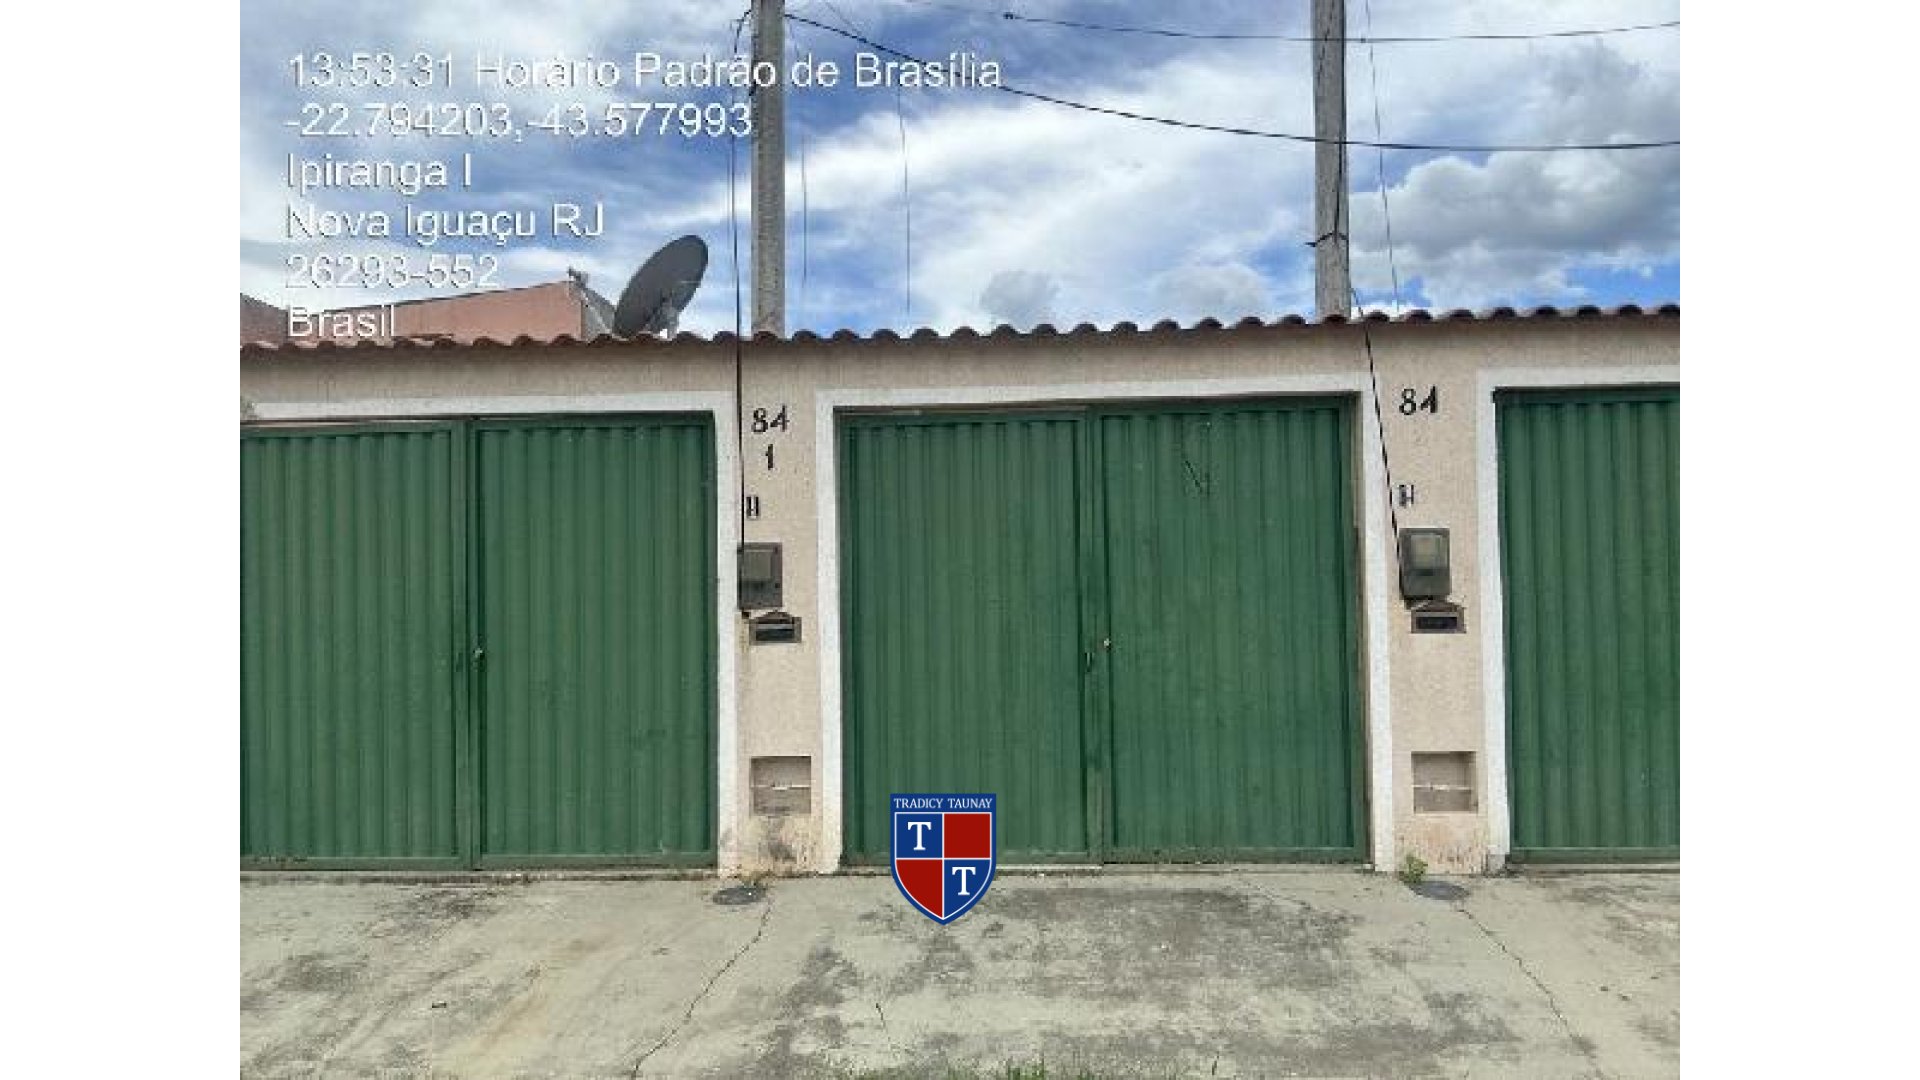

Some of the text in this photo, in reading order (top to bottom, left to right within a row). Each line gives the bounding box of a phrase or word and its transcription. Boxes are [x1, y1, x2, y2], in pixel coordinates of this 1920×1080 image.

[1399, 385, 1438, 416] 84
[751, 404, 790, 433] 84
[765, 444, 775, 471] 1
